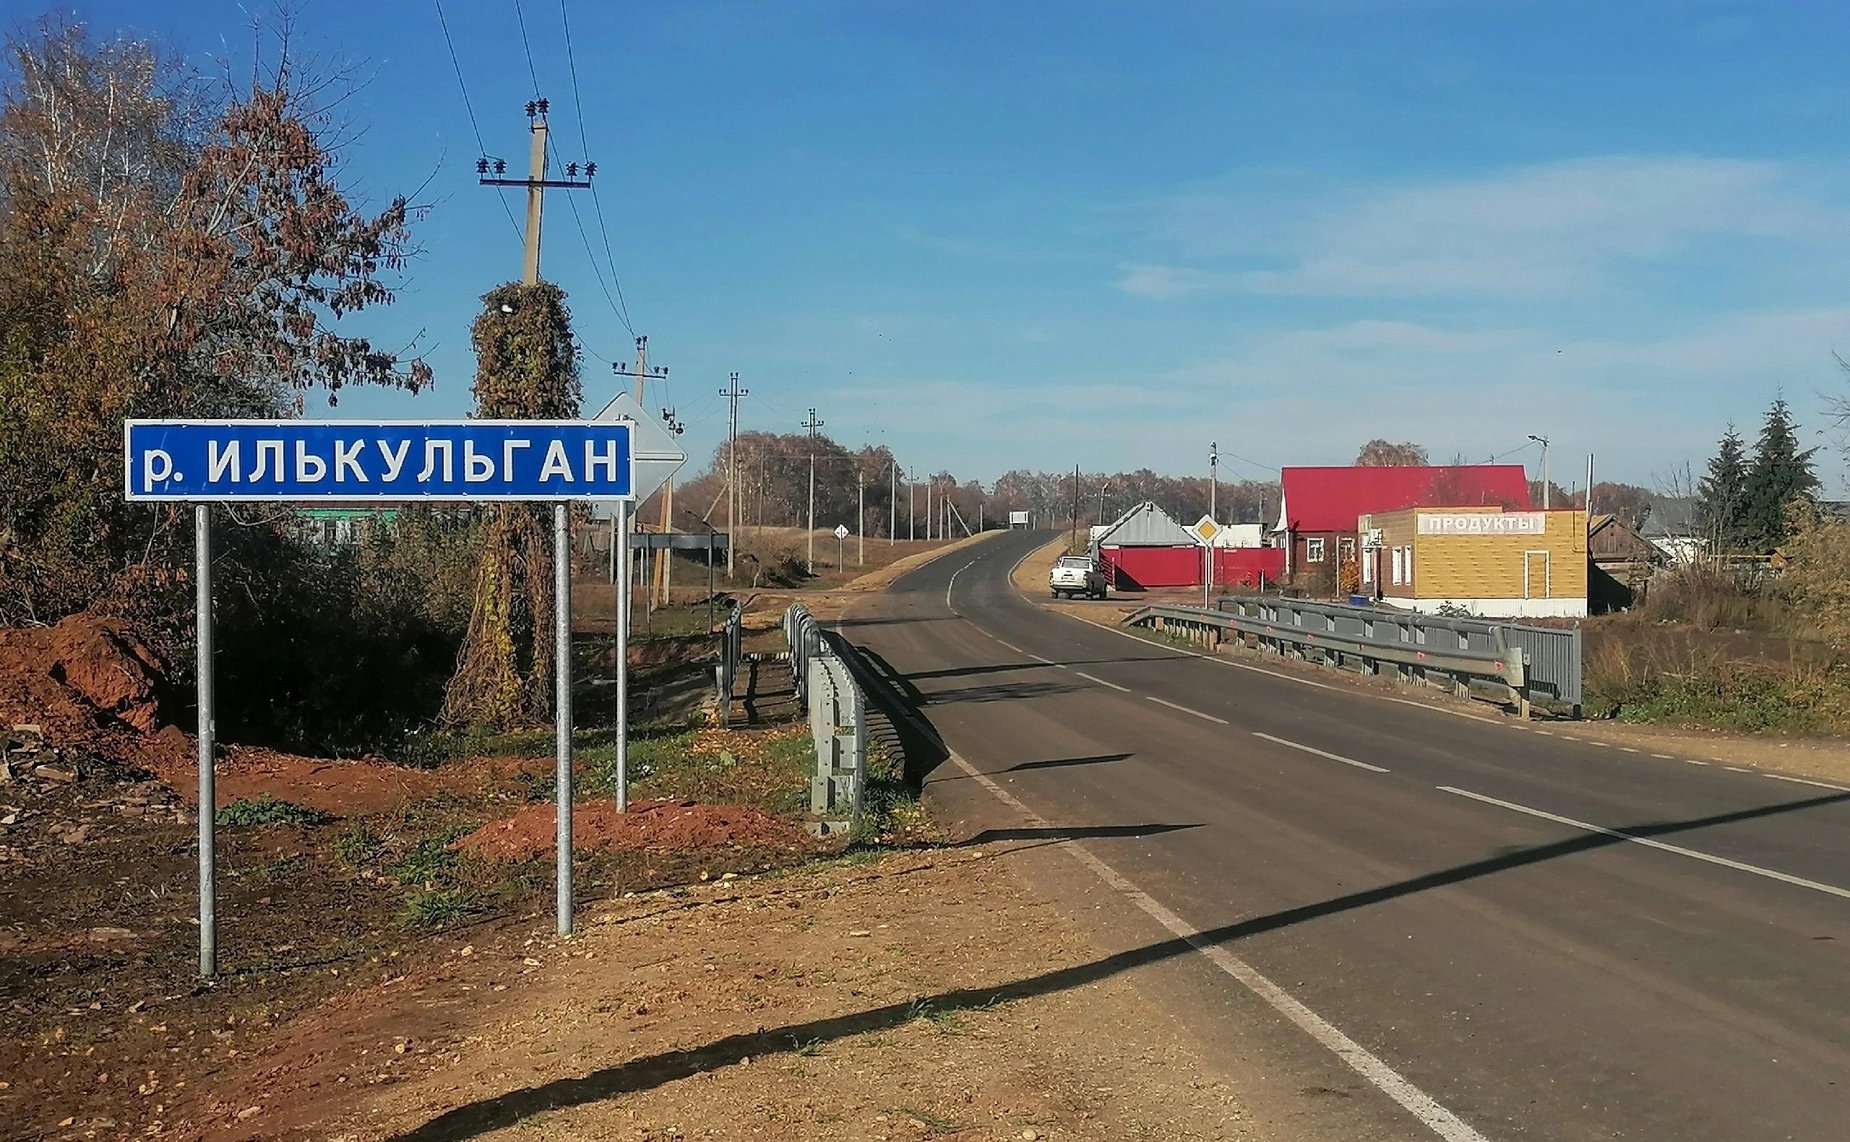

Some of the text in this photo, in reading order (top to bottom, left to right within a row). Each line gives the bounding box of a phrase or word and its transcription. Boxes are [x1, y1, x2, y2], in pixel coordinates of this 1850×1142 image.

[143, 439, 618, 492] р. ИЛЬКУЛЬГАН
[1429, 517, 1534, 532] ПРОДУКТЫ
